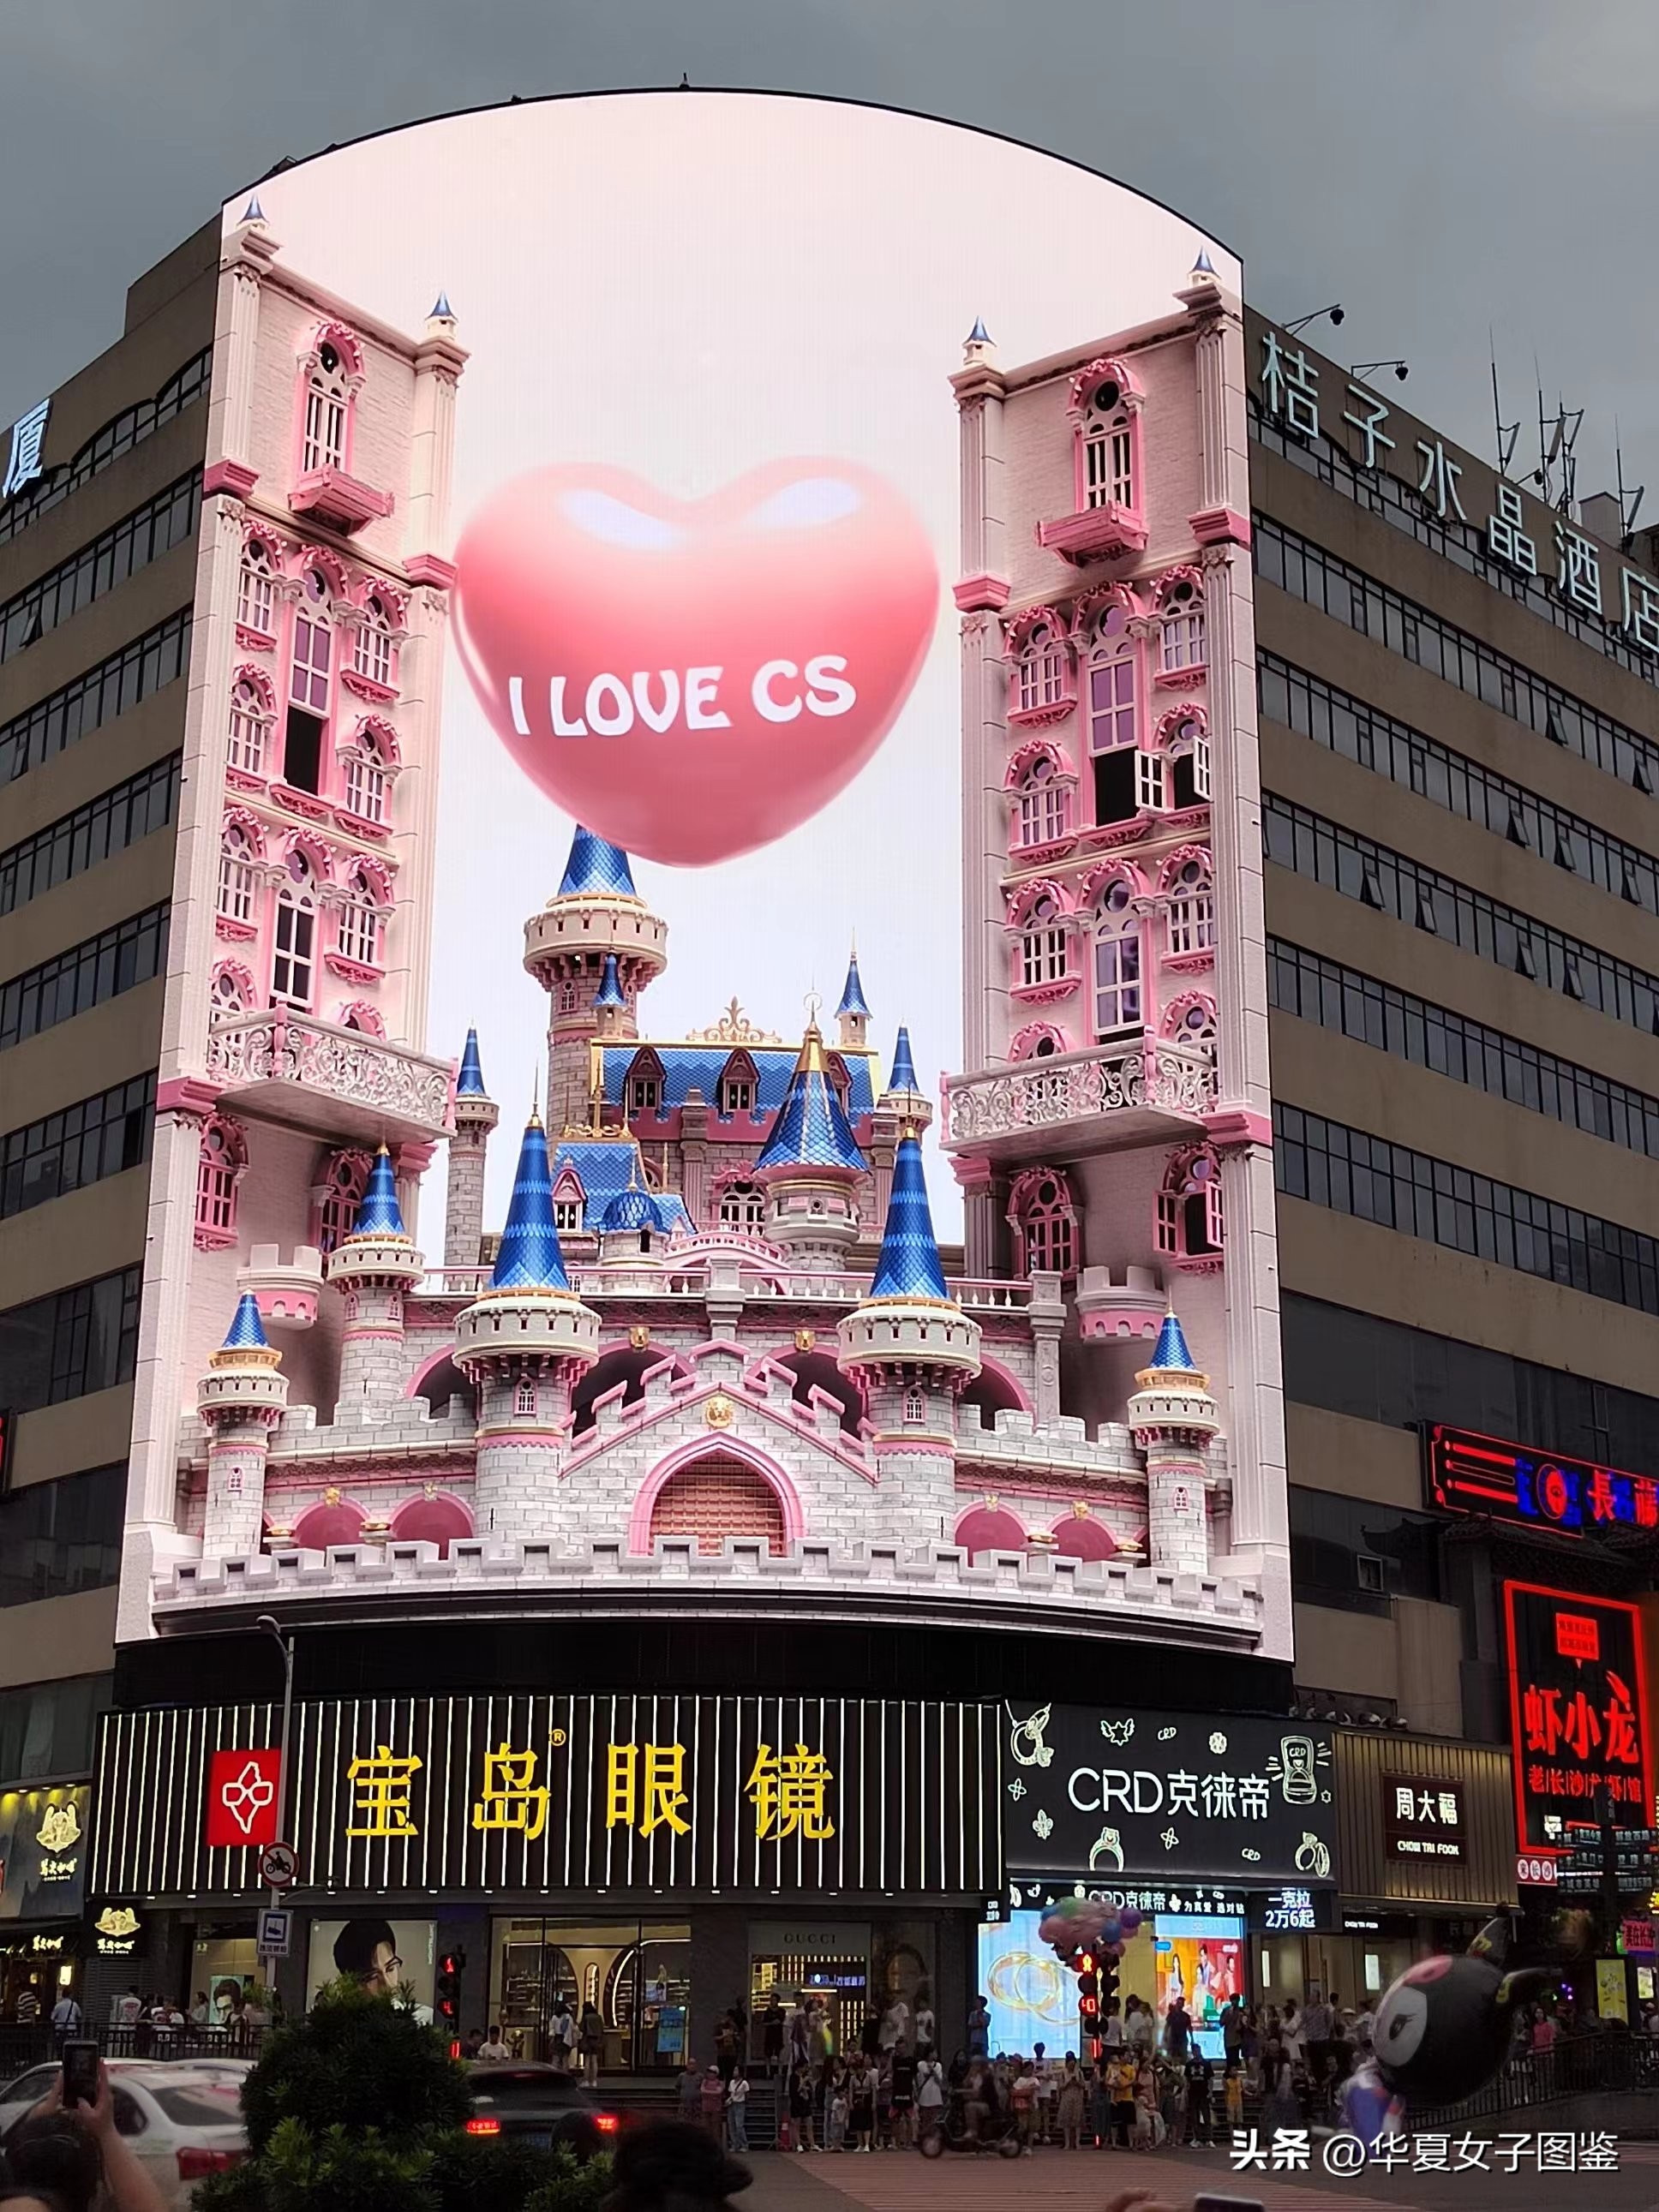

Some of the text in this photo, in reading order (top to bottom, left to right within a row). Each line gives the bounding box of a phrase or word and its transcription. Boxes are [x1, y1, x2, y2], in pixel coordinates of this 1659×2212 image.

[3, 398, 50, 499] 厦
[1262, 331, 1659, 654] 桔子水晶酒店
[508, 654, 857, 738] I LOVE CS
[1524, 1670, 1639, 1765] 虾小龙
[1158, 1726, 1177, 1742] CRD
[1288, 1746, 1308, 1759] CRD
[1395, 1786, 1458, 1826] 周大福
[1241, 1847, 1261, 1862] CRD
[1397, 1840, 1422, 1853] CHOW
[1437, 1844, 1459, 1856] FOOK
[1267, 1890, 1314, 1910] 一克拉
[1265, 1909, 1316, 1928] 2万6起
[783, 1933, 836, 1945] GUCCI
